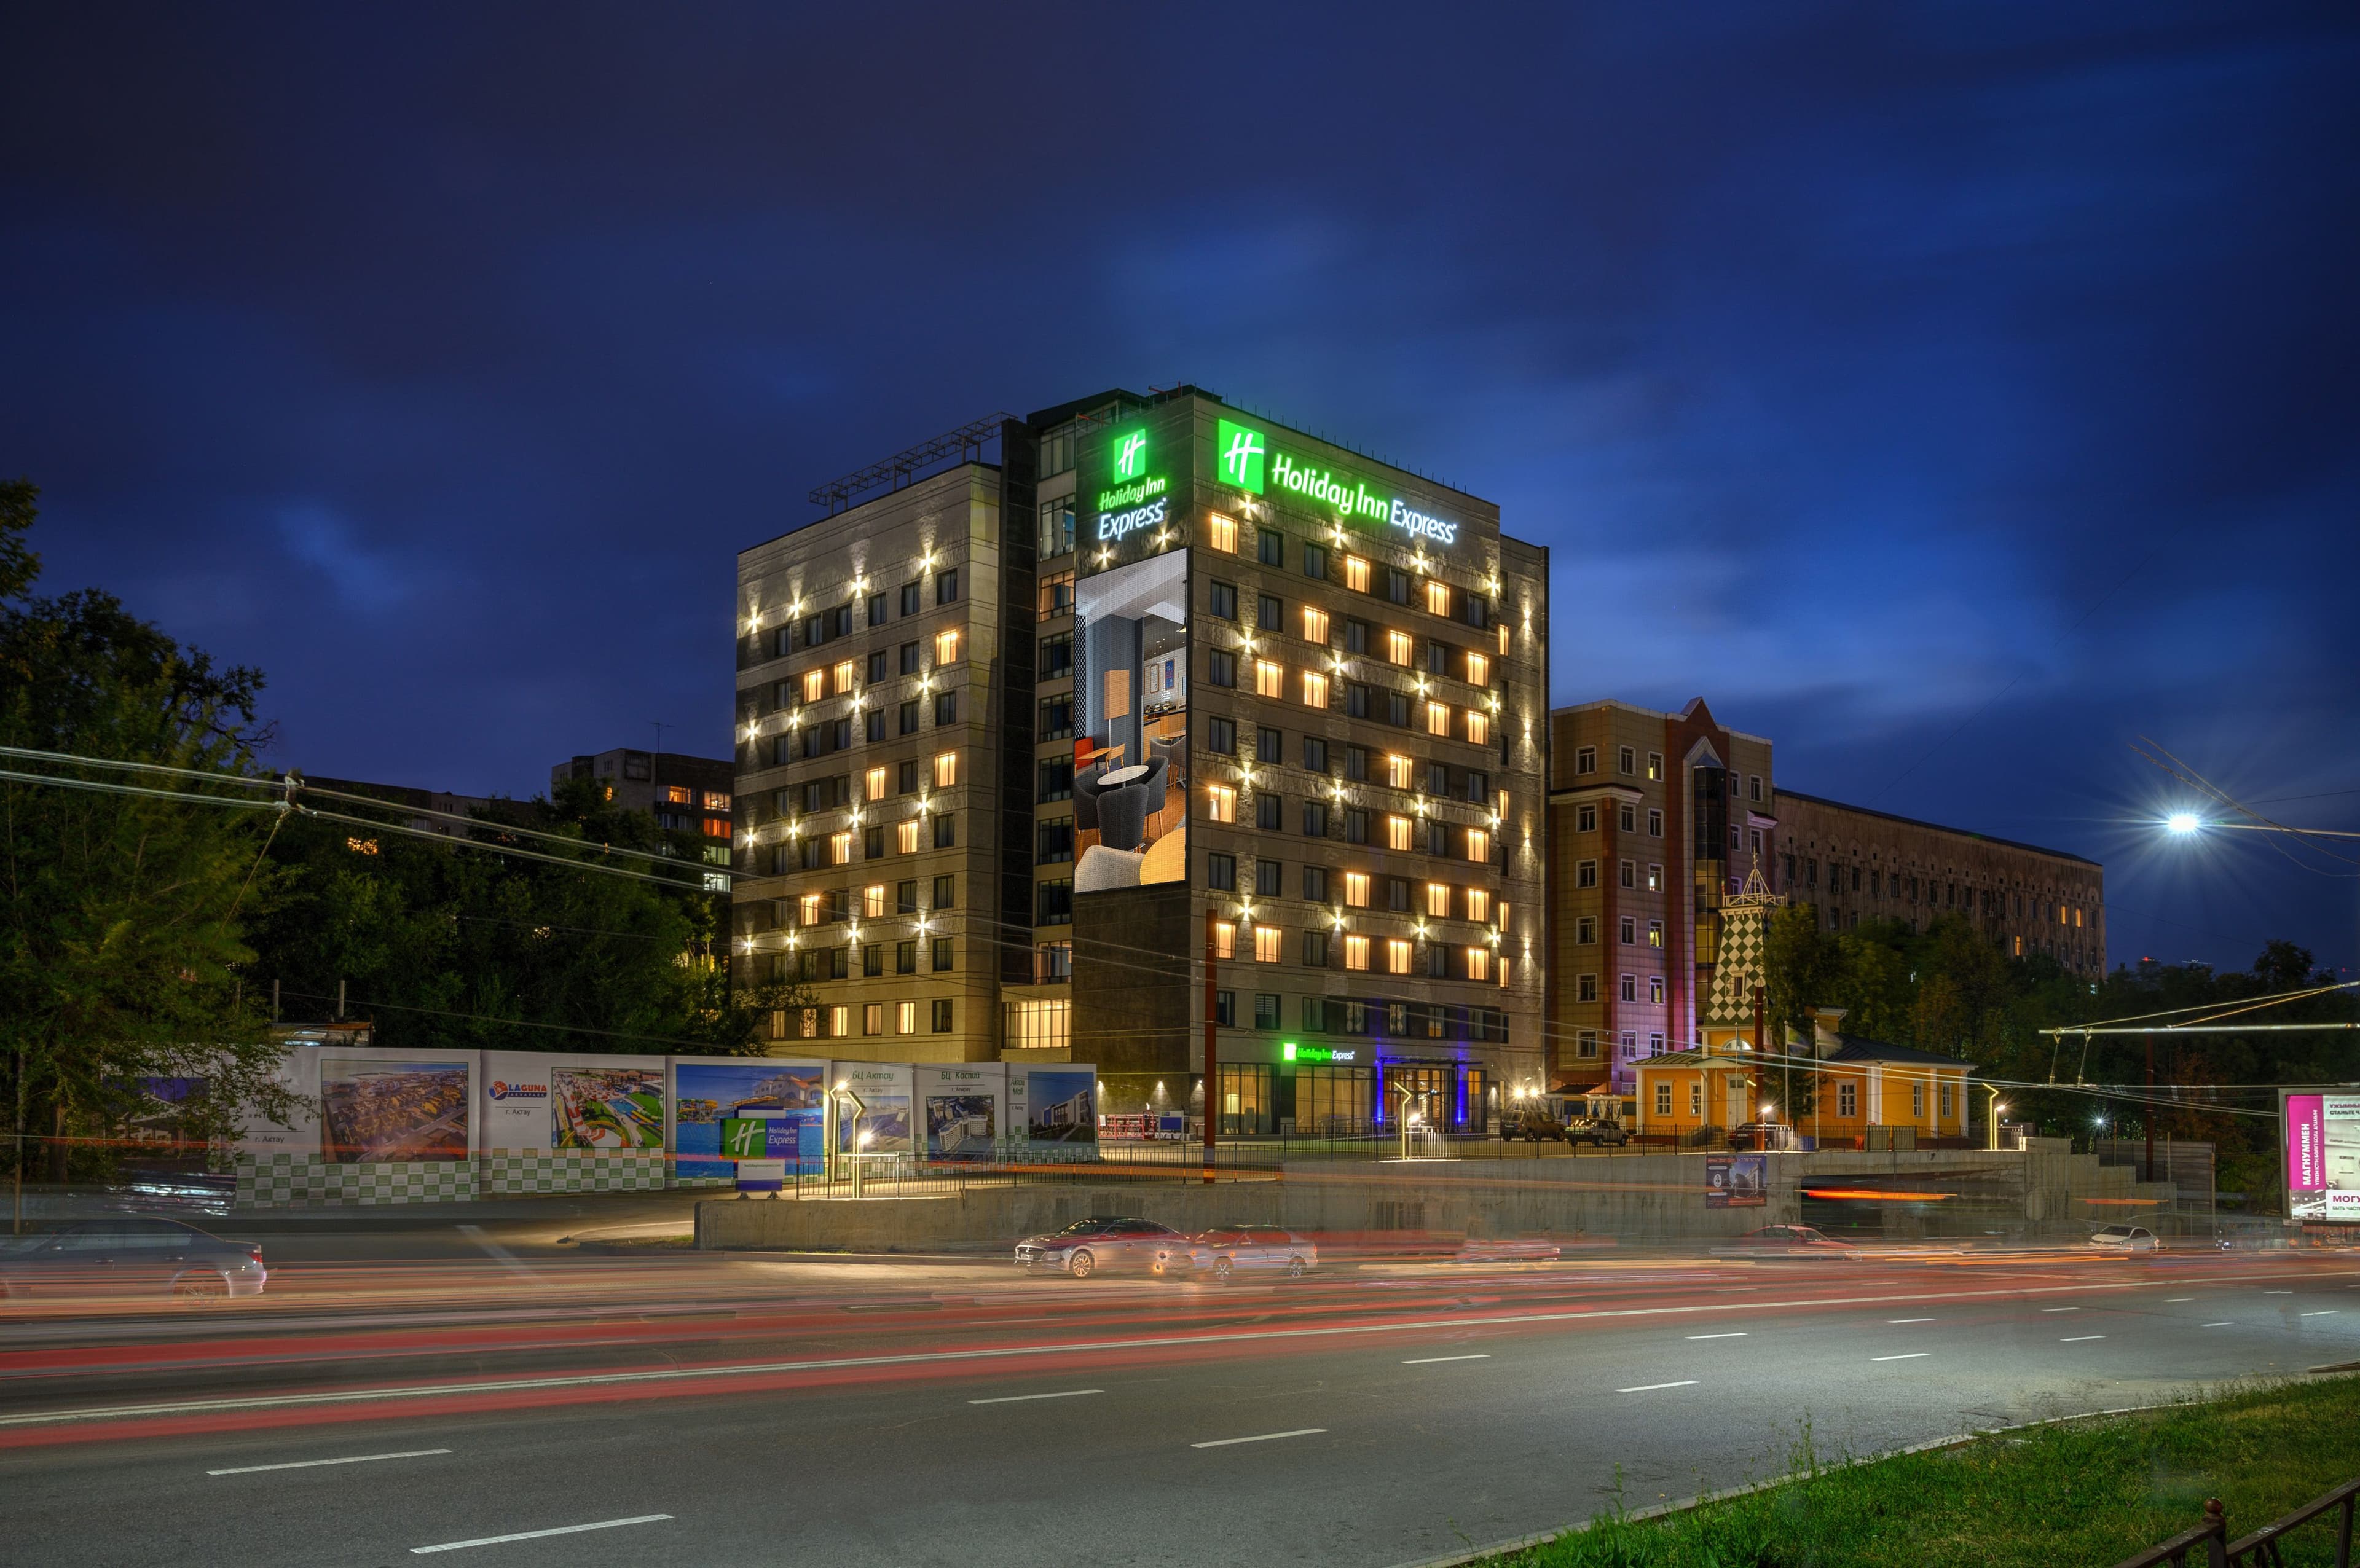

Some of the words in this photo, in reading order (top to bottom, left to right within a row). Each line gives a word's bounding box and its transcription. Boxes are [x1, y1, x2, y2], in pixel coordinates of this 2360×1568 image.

[1099, 484, 1144, 511] Holiday
[1145, 477, 1165, 496] Inn
[1272, 453, 1355, 515] Holiday
[1356, 483, 1388, 522] Inn
[1390, 498, 1455, 544] Express
[1098, 501, 1164, 541] Express
[1297, 1047, 1321, 1061] Holiday
[1322, 1048, 1332, 1059] Inn
[1332, 1050, 1353, 1061] Express
[852, 1070, 863, 1081] БЦ
[866, 1071, 894, 1081] Актау
[941, 1071, 951, 1081] БЦ
[955, 1071, 980, 1080] Каспий
[768, 1135, 796, 1145] Express
[2301, 1123, 2311, 1185] МАГНУММЕН
